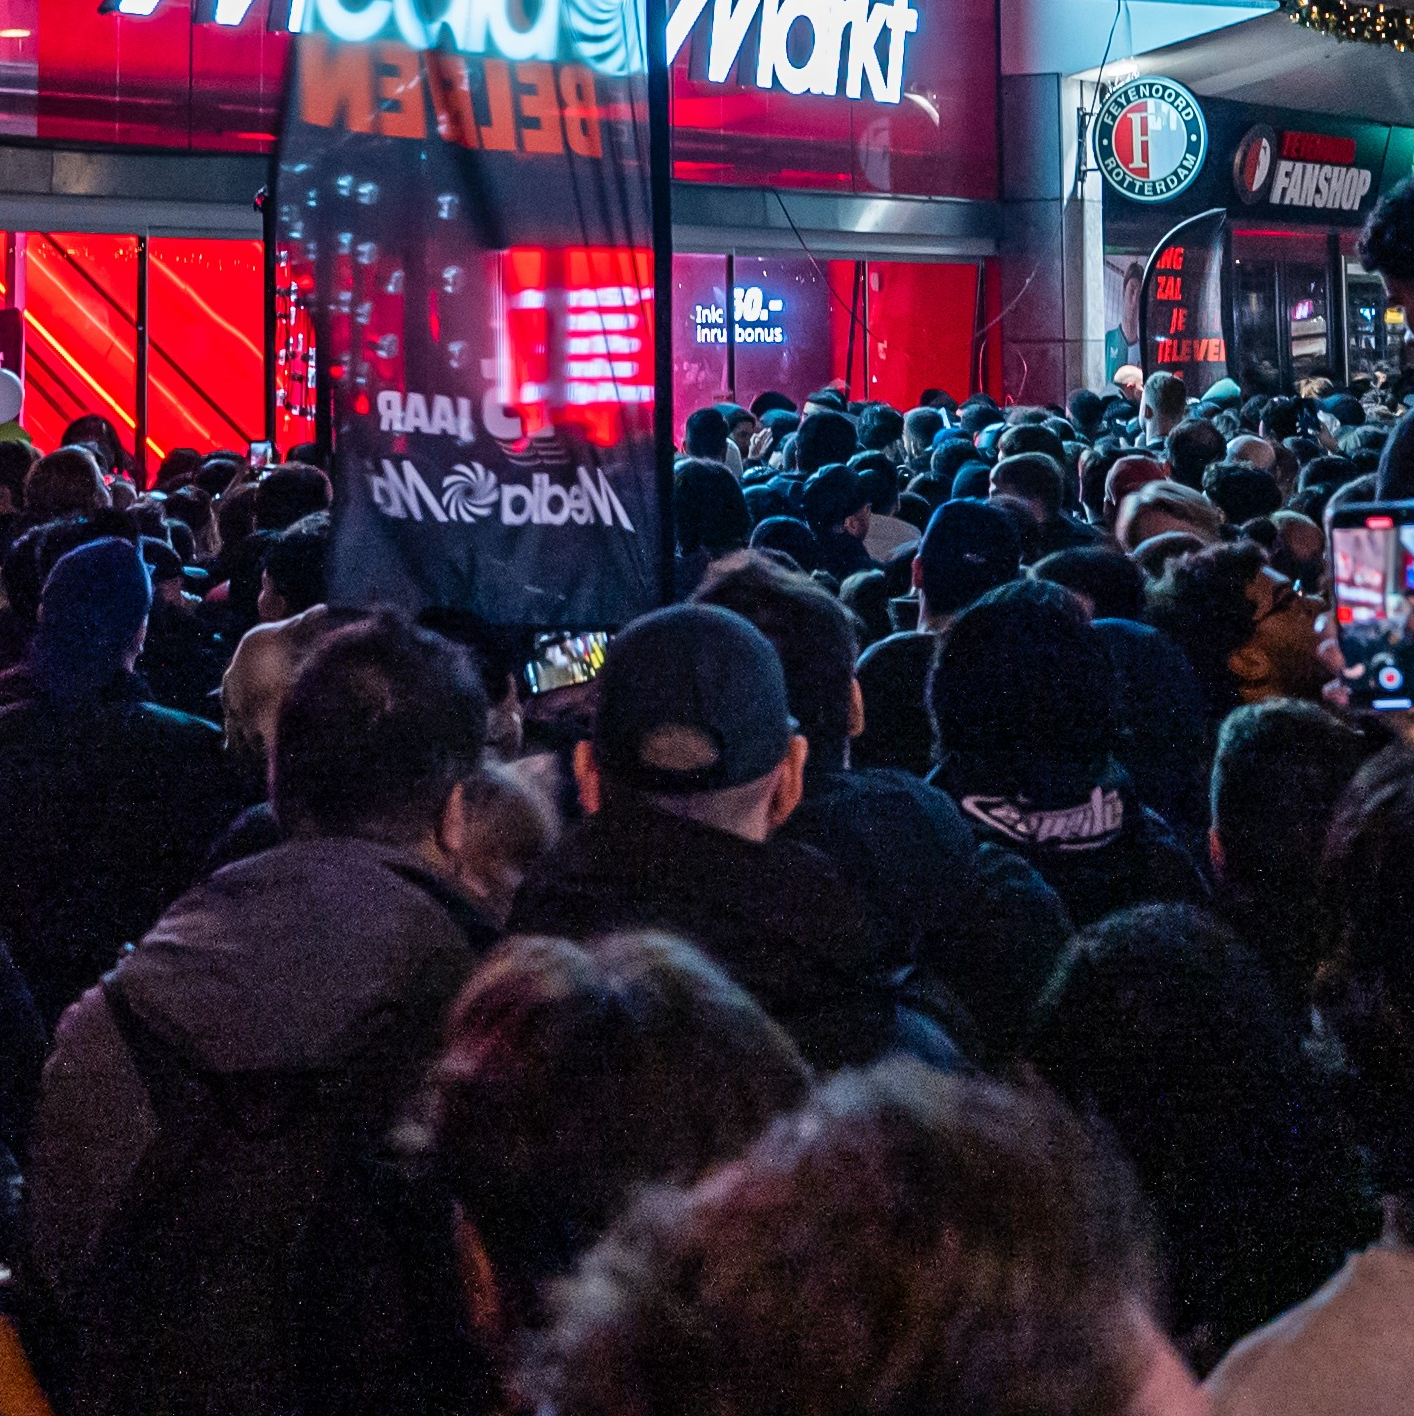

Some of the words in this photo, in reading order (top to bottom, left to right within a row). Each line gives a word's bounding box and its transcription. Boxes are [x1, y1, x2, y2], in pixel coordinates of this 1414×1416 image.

[1103, 83, 1194, 126] FEYENOORD
[1104, 153, 1197, 196] ROTTERDAM
[1268, 159, 1372, 212] FANSHOP
[1156, 275, 1182, 301] ZAL
[1169, 307, 1186, 335] JE
